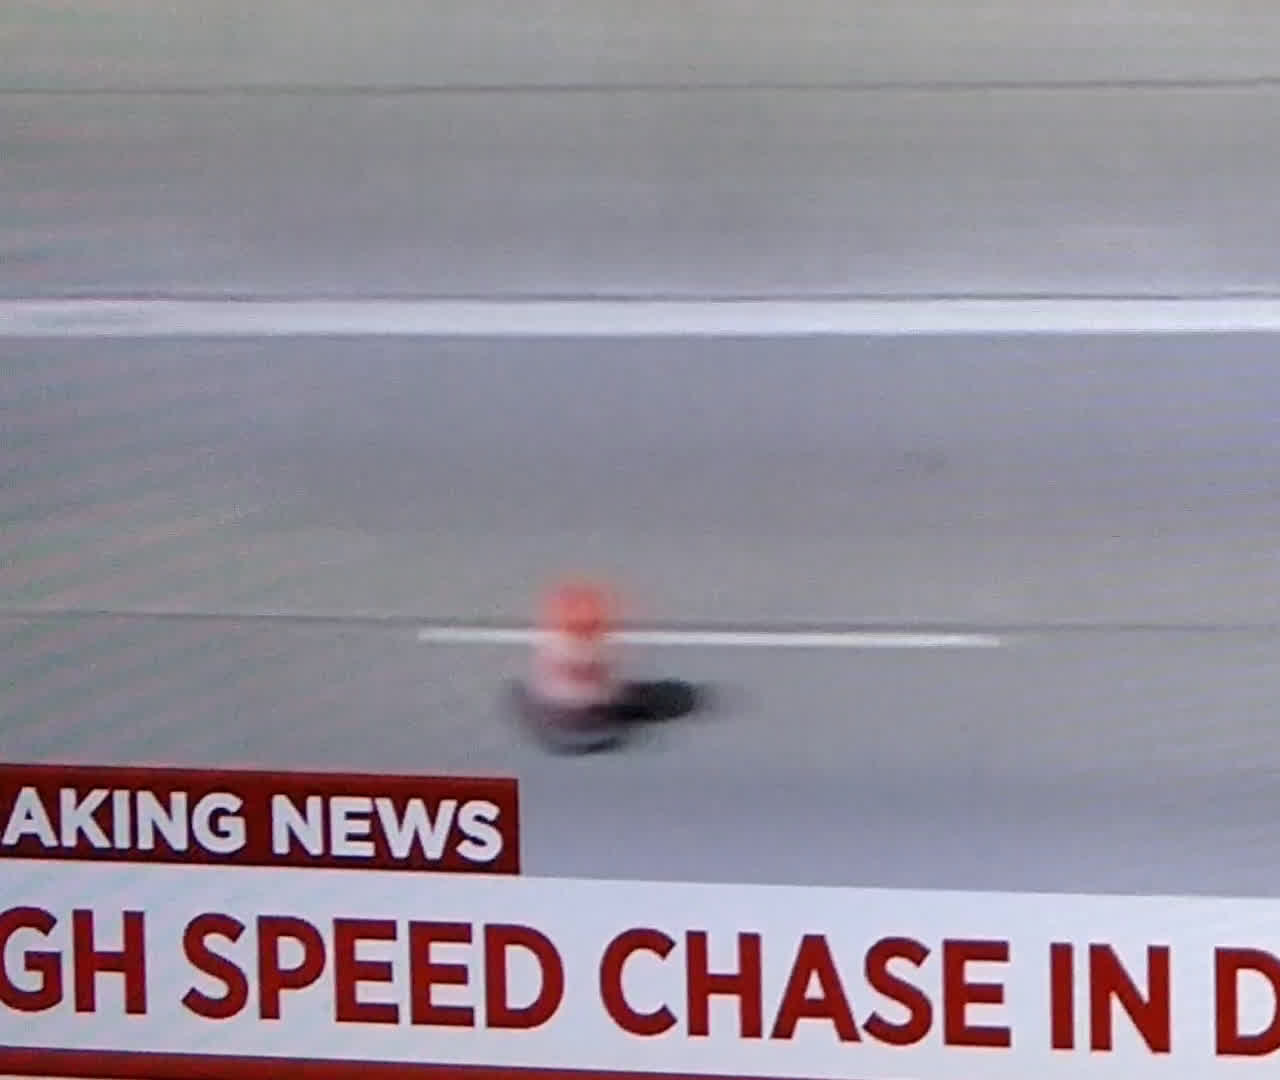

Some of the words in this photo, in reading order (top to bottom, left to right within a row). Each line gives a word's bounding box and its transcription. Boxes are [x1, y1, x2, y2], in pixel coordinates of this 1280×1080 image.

[2, 786, 247, 854] AKING
[272, 794, 503, 862] NEWS
[0, 907, 146, 1015] GH
[182, 914, 565, 1031] SPEED
[601, 928, 1011, 1049] CHASE
[1050, 942, 1171, 1054] IN
